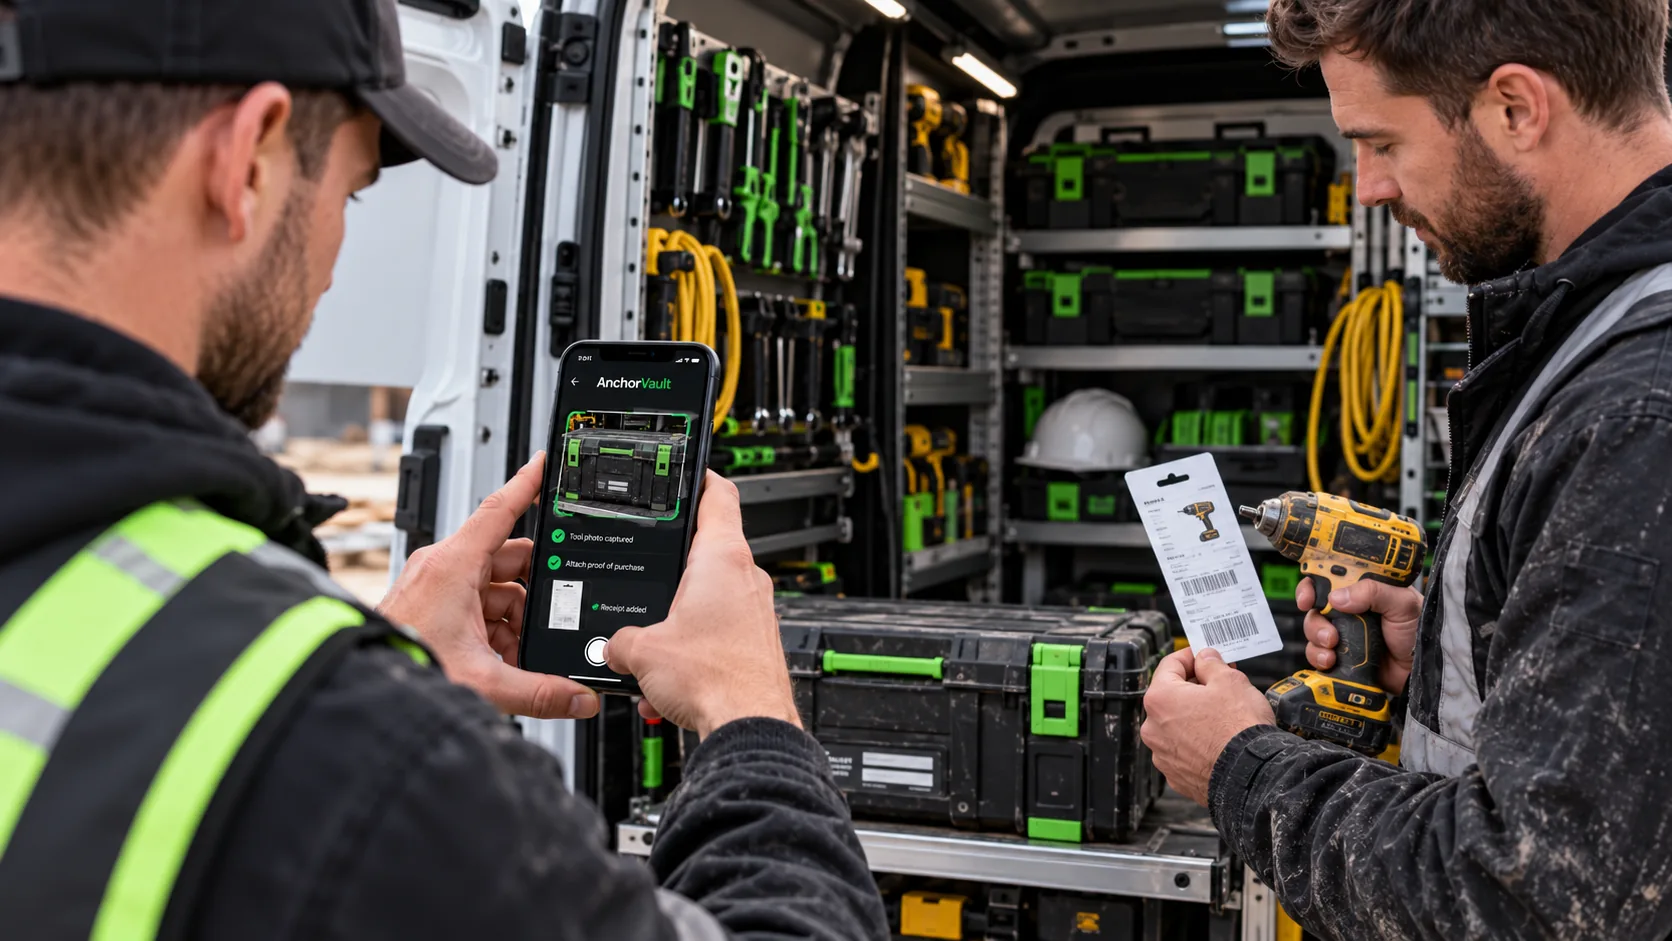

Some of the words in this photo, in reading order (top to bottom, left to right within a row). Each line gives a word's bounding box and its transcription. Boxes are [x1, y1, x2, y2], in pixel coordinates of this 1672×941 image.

[596, 376, 672, 389] AnchorVault
[584, 533, 603, 542] photo
[604, 535, 634, 543] captured
[565, 560, 587, 568] Attach
[587, 562, 605, 570] proof
[600, 603, 625, 612] Receipt
